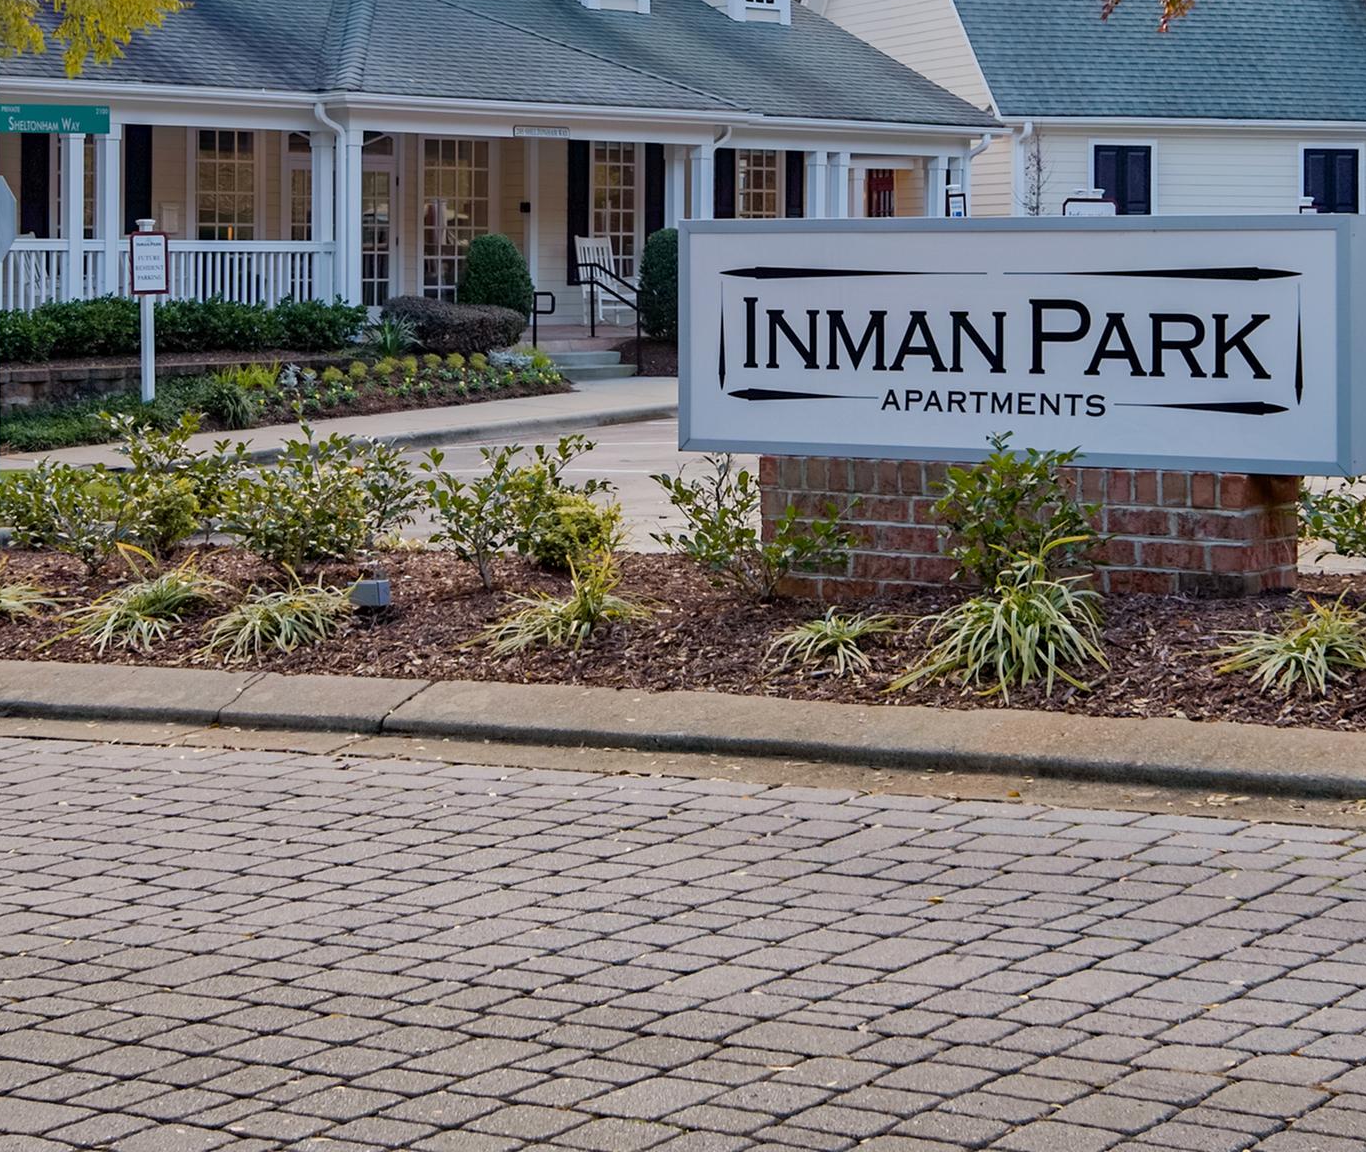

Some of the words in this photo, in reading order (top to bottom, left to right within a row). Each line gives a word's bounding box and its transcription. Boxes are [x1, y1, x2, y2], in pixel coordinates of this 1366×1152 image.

[8, 116, 59, 132] SHELTONHAM
[61, 117, 81, 131] WAY
[742, 296, 1007, 374] INMAN
[1028, 298, 1273, 380] PARK
[880, 389, 1107, 418] APARTMENTS
